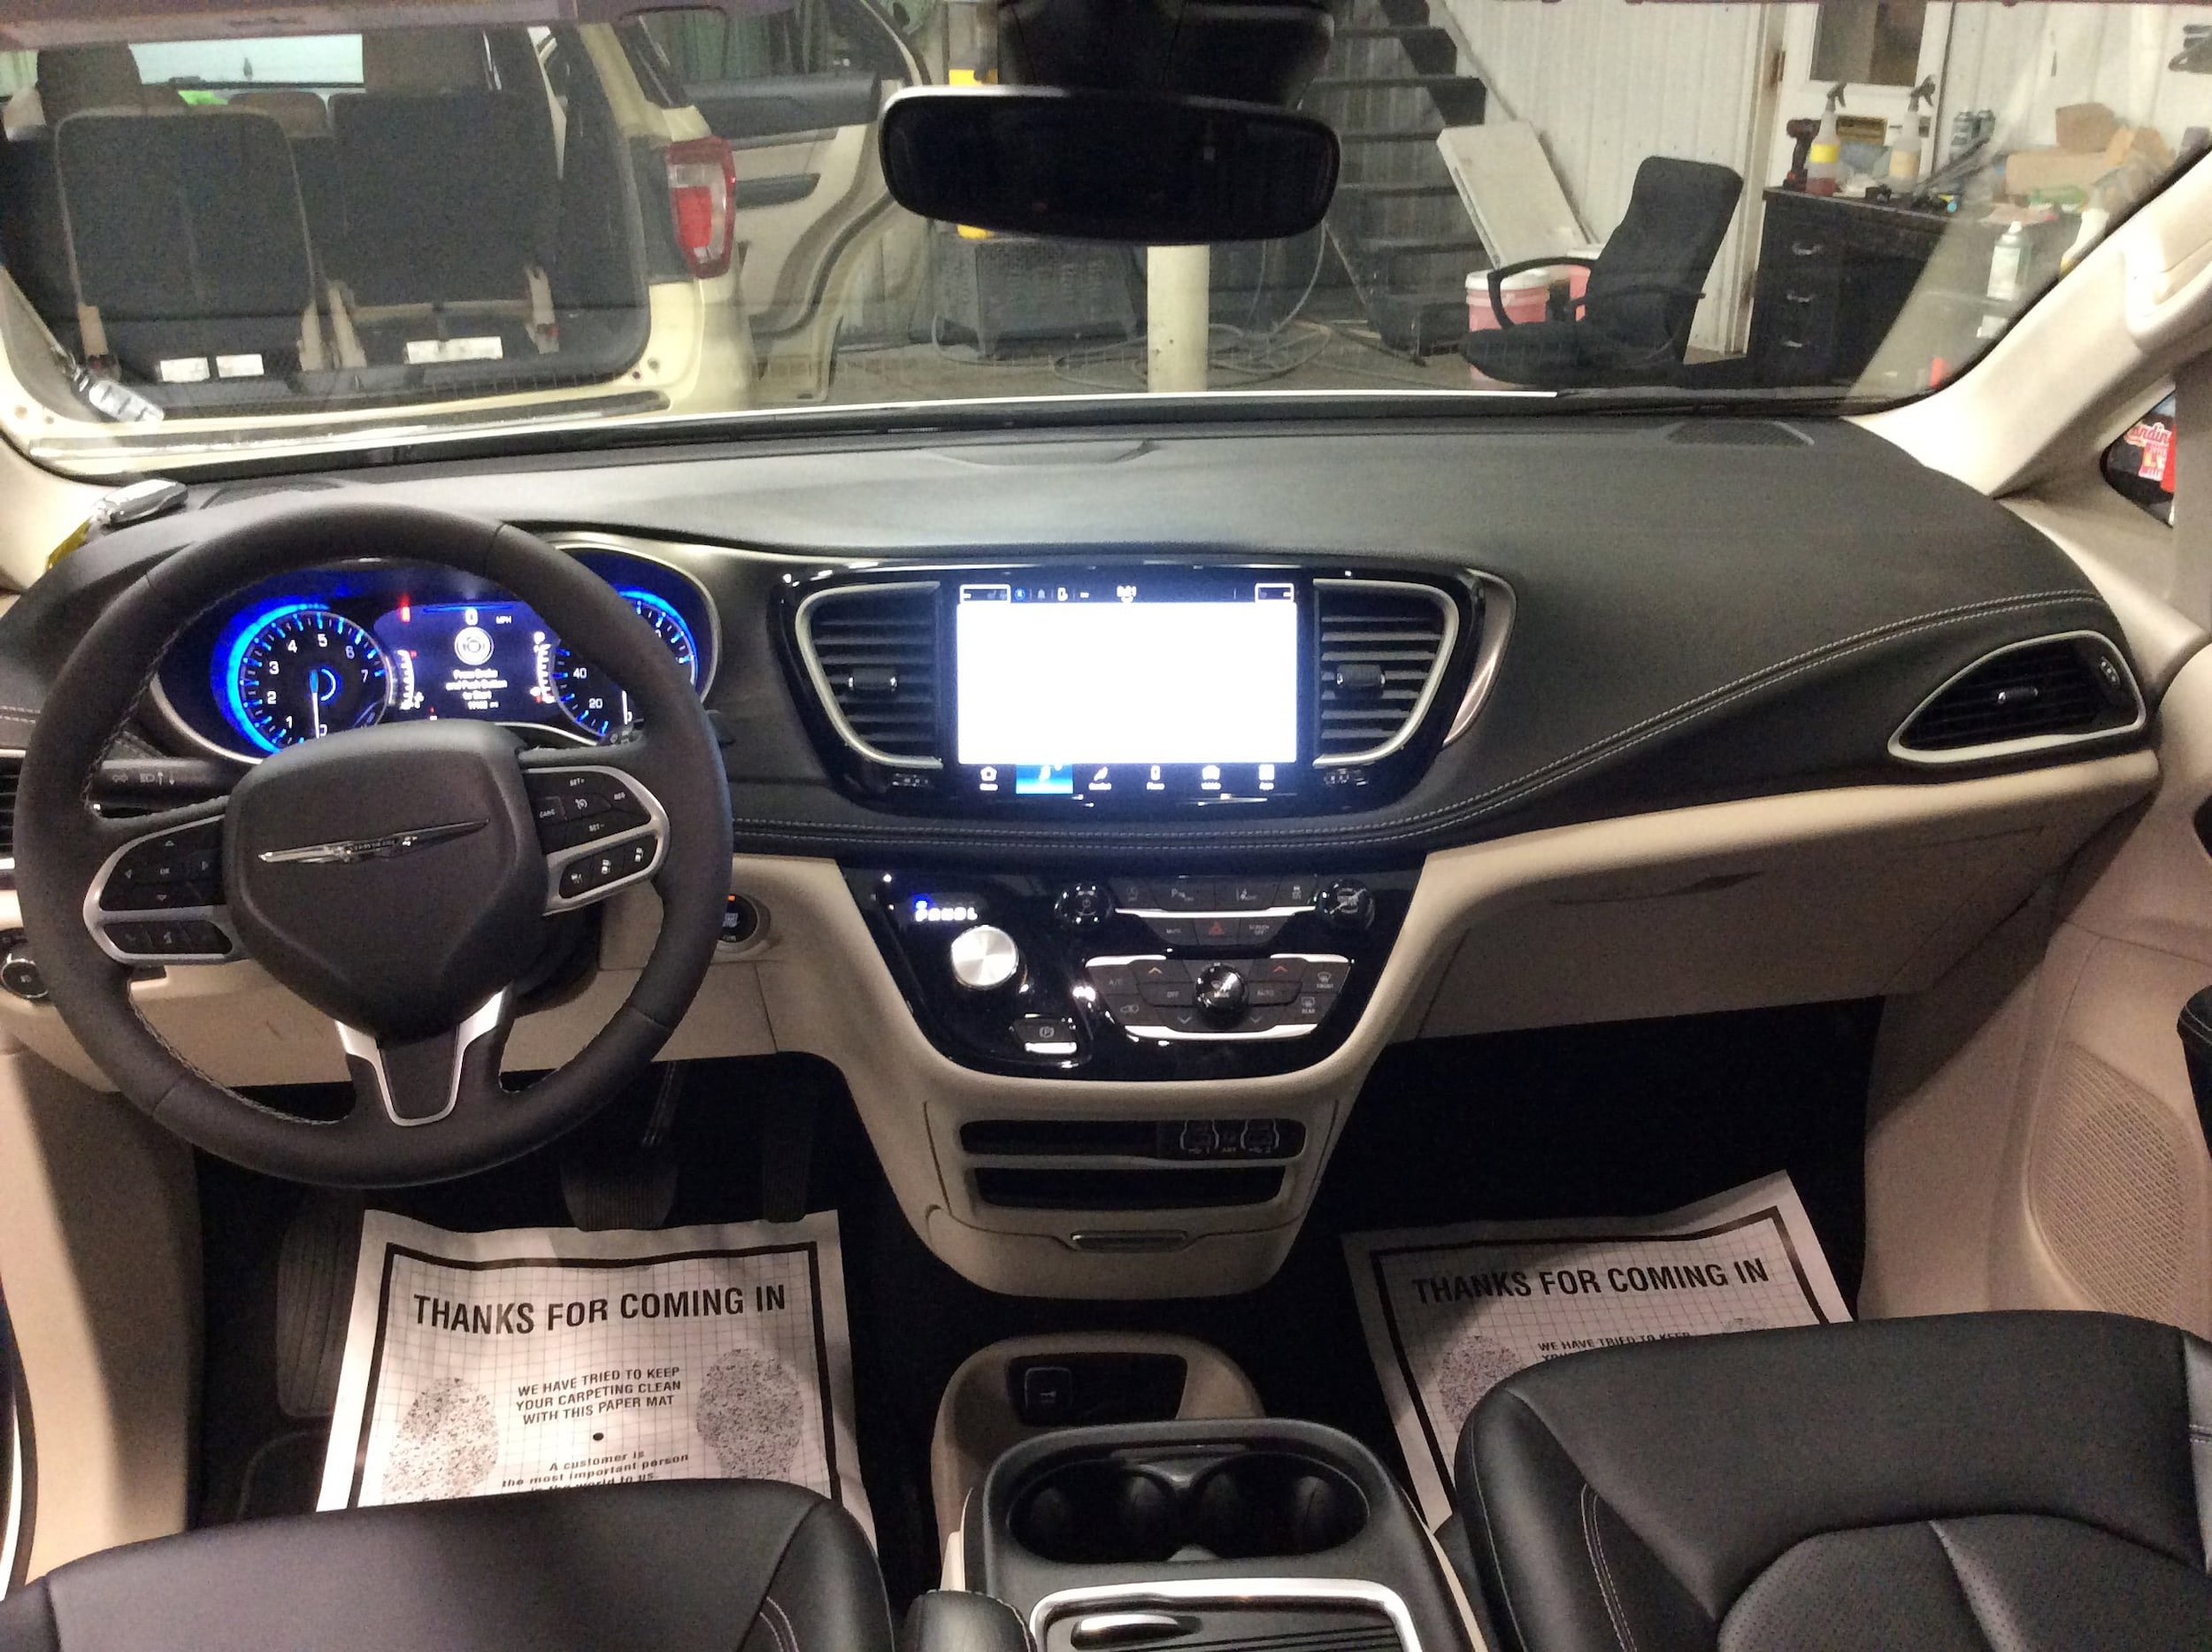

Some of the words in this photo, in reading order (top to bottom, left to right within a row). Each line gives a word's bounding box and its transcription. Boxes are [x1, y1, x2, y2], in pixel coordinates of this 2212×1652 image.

[288, 640, 298, 653] 4
[318, 634, 327, 647] 5
[345, 645, 355, 659] 6
[269, 661, 280, 675] 3
[572, 667, 588, 679] 40
[361, 669, 369, 682] 7
[266, 690, 277, 704] 2
[588, 698, 603, 709] 20
[286, 716, 293, 729] 1
[1413, 1271, 1532, 1305] THANKS
[1539, 1269, 1601, 1295] FOR
[1607, 1263, 1729, 1293] COMING
[1733, 1257, 1770, 1284] IN
[413, 1294, 535, 1335] THANKS
[547, 1298, 609, 1331] FOR
[620, 1287, 744, 1319] COMING
[756, 1284, 785, 1312] IN
[1537, 1341, 1558, 1351] WE
[1560, 1338, 1595, 1349] HAVE
[518, 1384, 539, 1397] WE
[542, 1378, 577, 1394] HAVE
[581, 1371, 621, 1387] TRIED
[626, 1368, 642, 1380] TO
[647, 1366, 680, 1379] KEEP
[516, 1396, 554, 1411] YOUR
[558, 1383, 634, 1406] CARPETING
[638, 1380, 681, 1394] CLEAN
[523, 1410, 558, 1425] WITH
[563, 1404, 594, 1419] THIS
[598, 1397, 641, 1414] PAPER
[646, 1395, 675, 1408] MAT
[549, 1463, 559, 1471] A
[564, 1452, 628, 1470] customer
[633, 1449, 645, 1460] is
[502, 1479, 525, 1488] the
[529, 1472, 565, 1485] most
[569, 1460, 638, 1480] important
[641, 1453, 690, 1471] person
[638, 1471, 655, 1482] us
